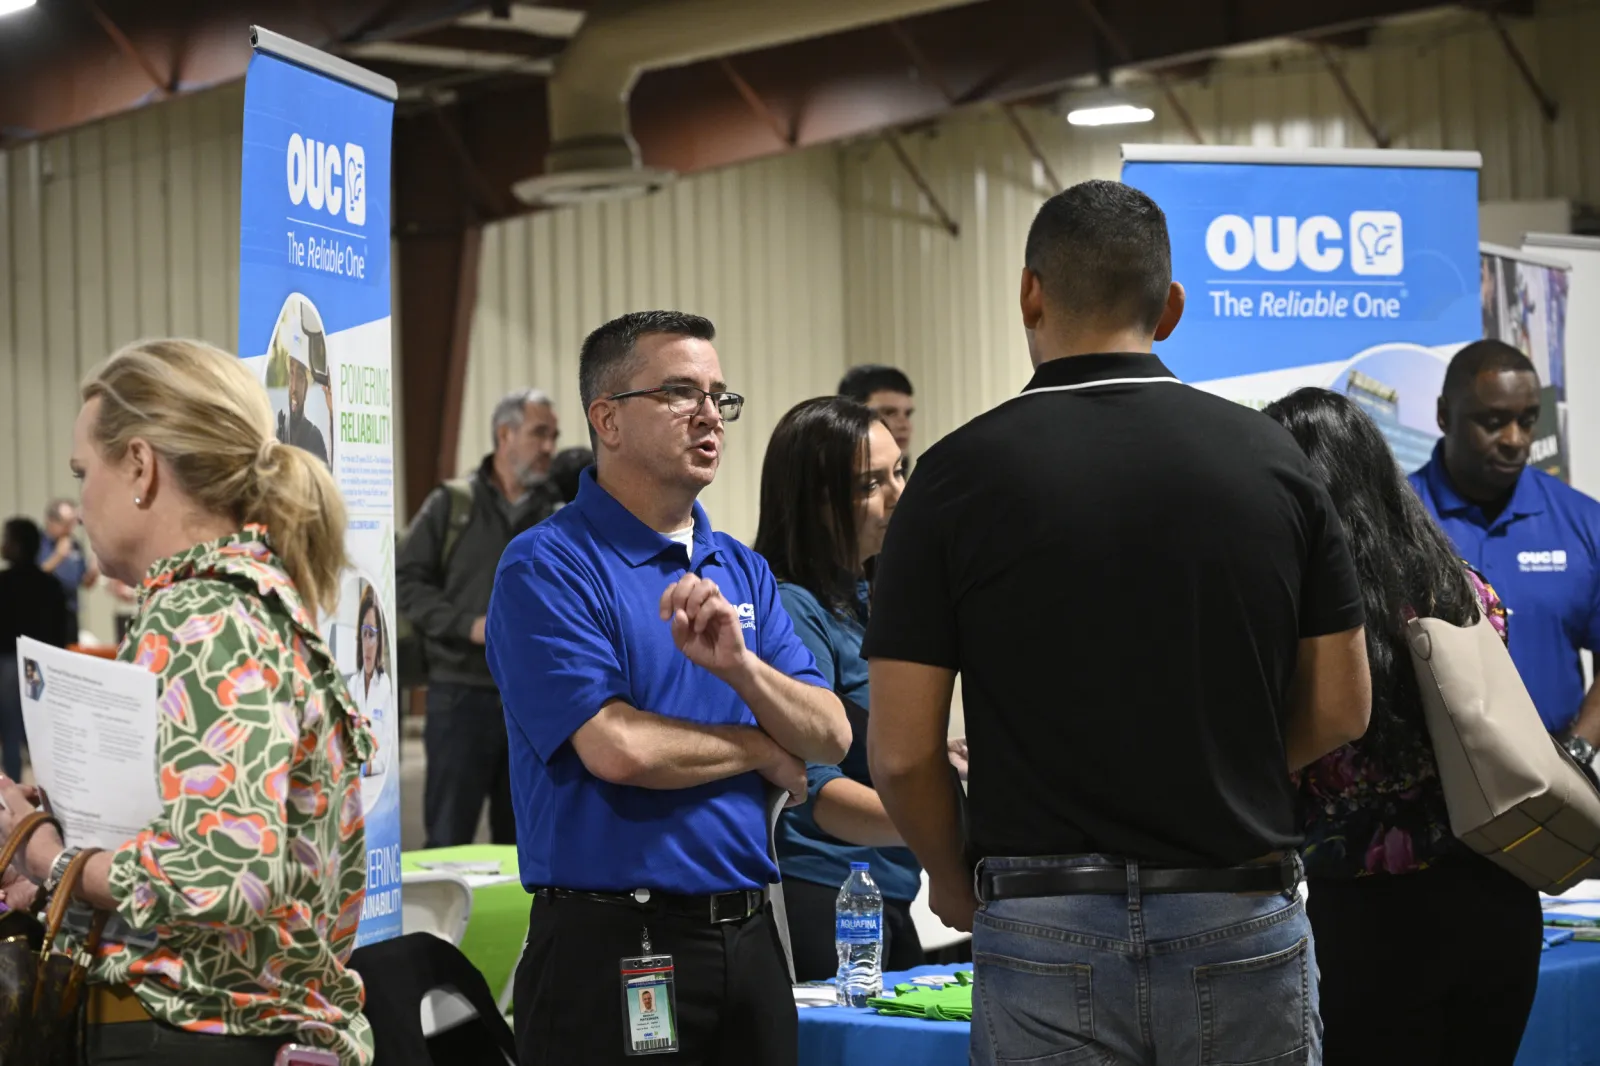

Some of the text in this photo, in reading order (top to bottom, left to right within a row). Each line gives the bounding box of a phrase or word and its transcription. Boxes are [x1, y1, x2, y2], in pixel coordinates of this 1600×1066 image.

[287, 132, 342, 215] OUC
[287, 231, 365, 279] The Reliable One
[1205, 214, 1344, 272] OUC
[1209, 289, 1401, 318] The Reliable One
[340, 363, 390, 407] POWERING
[340, 411, 390, 445] RELIABILITY
[1517, 551, 1552, 565] OUC
[841, 918, 877, 931] AQUAFINA
